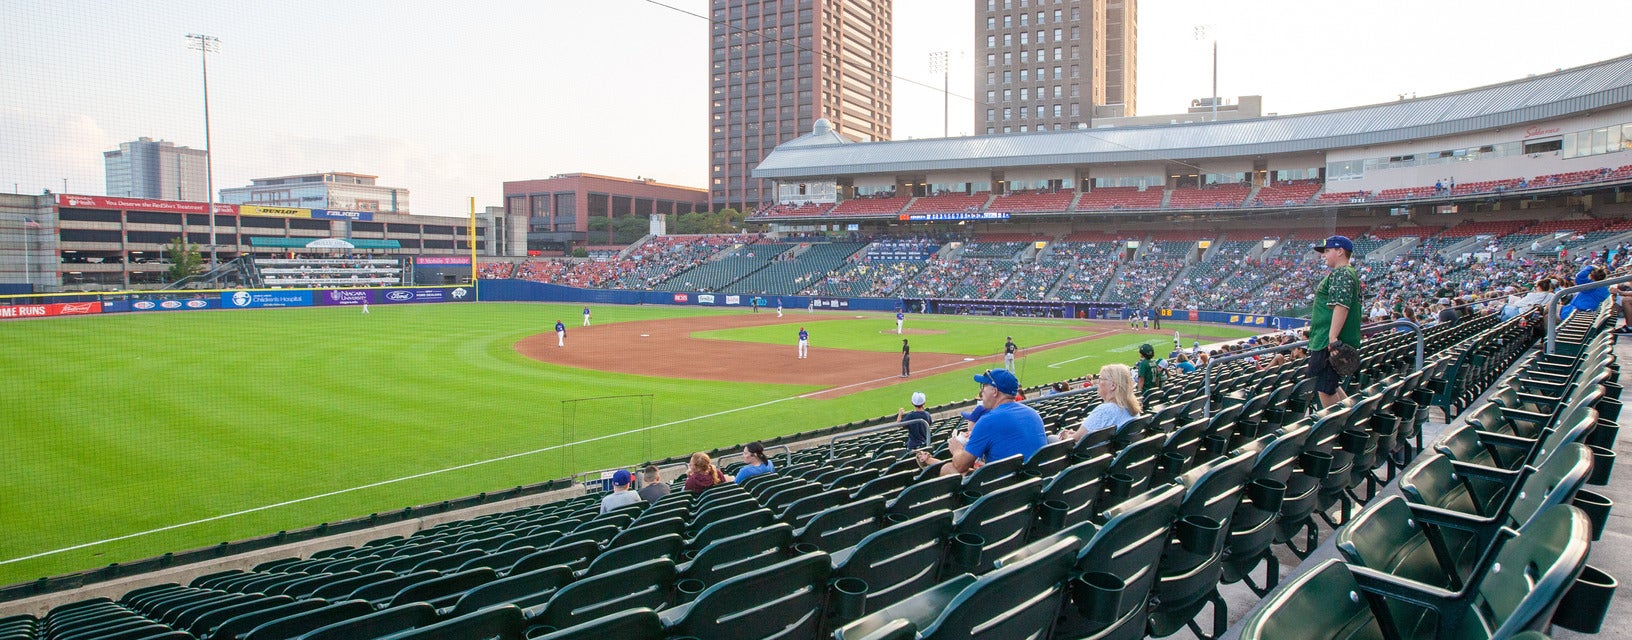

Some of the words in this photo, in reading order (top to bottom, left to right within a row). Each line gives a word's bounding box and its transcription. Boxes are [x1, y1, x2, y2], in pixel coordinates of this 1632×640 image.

[118, 200, 142, 208] Deserve
[177, 203, 203, 211] Treatment
[0, 307, 17, 317] ME
[18, 306, 46, 316] RUNS
